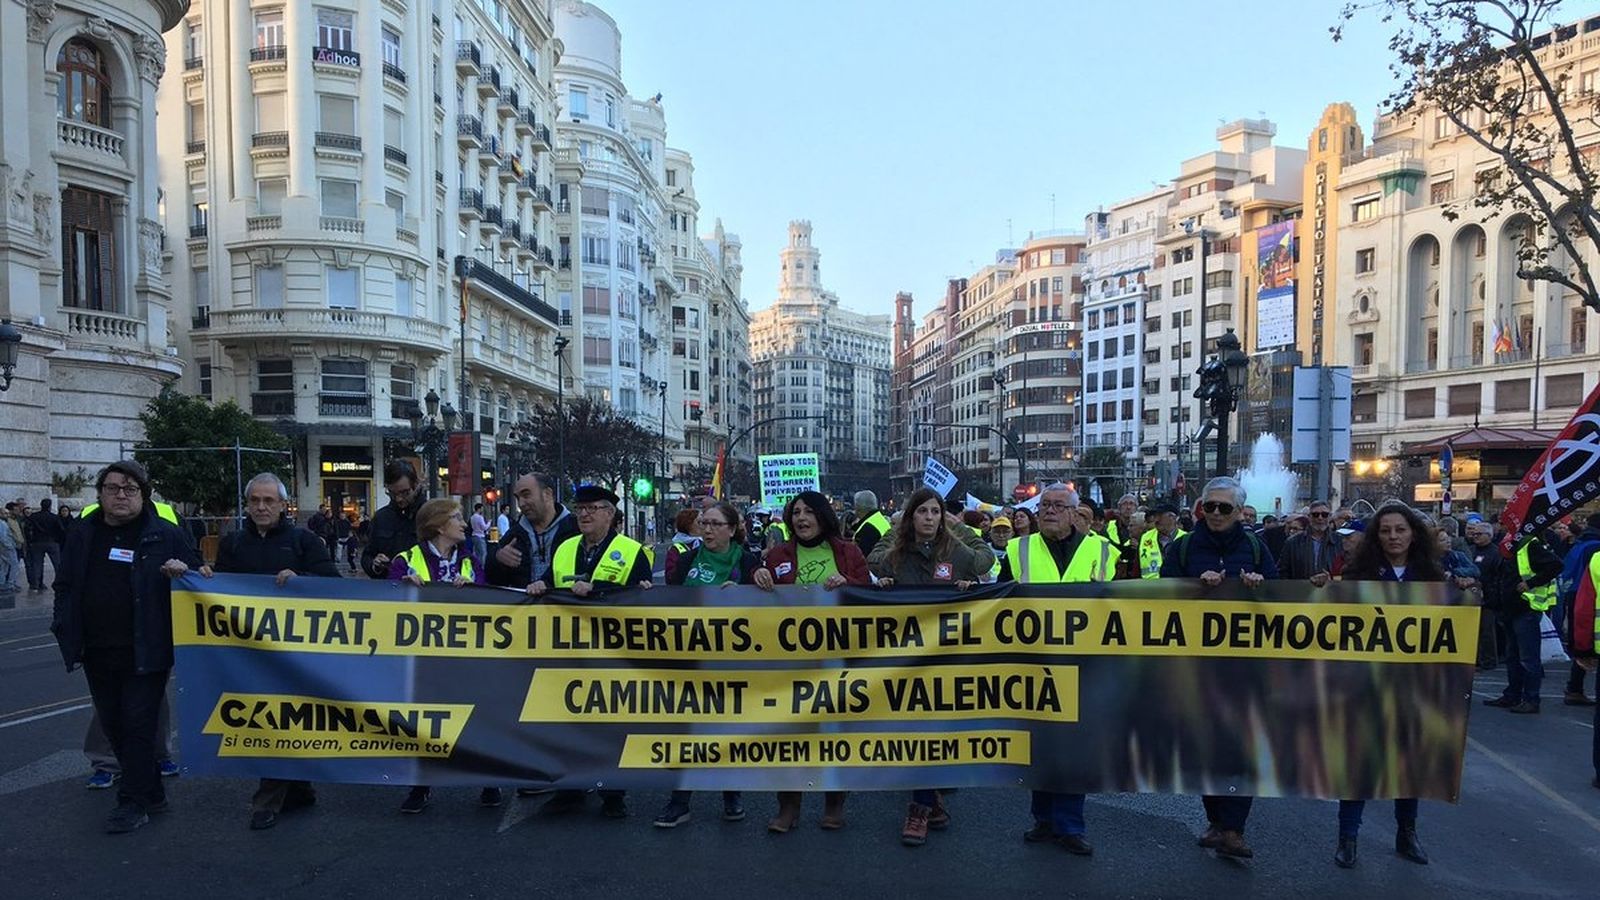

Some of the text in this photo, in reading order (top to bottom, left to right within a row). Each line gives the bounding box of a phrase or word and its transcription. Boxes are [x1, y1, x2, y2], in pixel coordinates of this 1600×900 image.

[317, 50, 358, 66] Adhoc
[1315, 174, 1325, 240] RIALTO
[1314, 254, 1325, 320] TEATRE
[762, 457, 816, 467] CUANDO TODO
[764, 480, 782, 488] NOS
[194, 603, 1458, 656] IGUALTAT, DRETS I LLIBERTATS. CONTRA EL COLP A LA DEMOCRÀCIA
[564, 668, 1062, 714] CAMINANT - PAÍS VALENCIÀ
[220, 699, 451, 739] CAMINANT
[224, 734, 450, 754] si ens movem, canviem tot
[650, 736, 1011, 764] SI ENS MOVEM HO CANVIEM TOT
